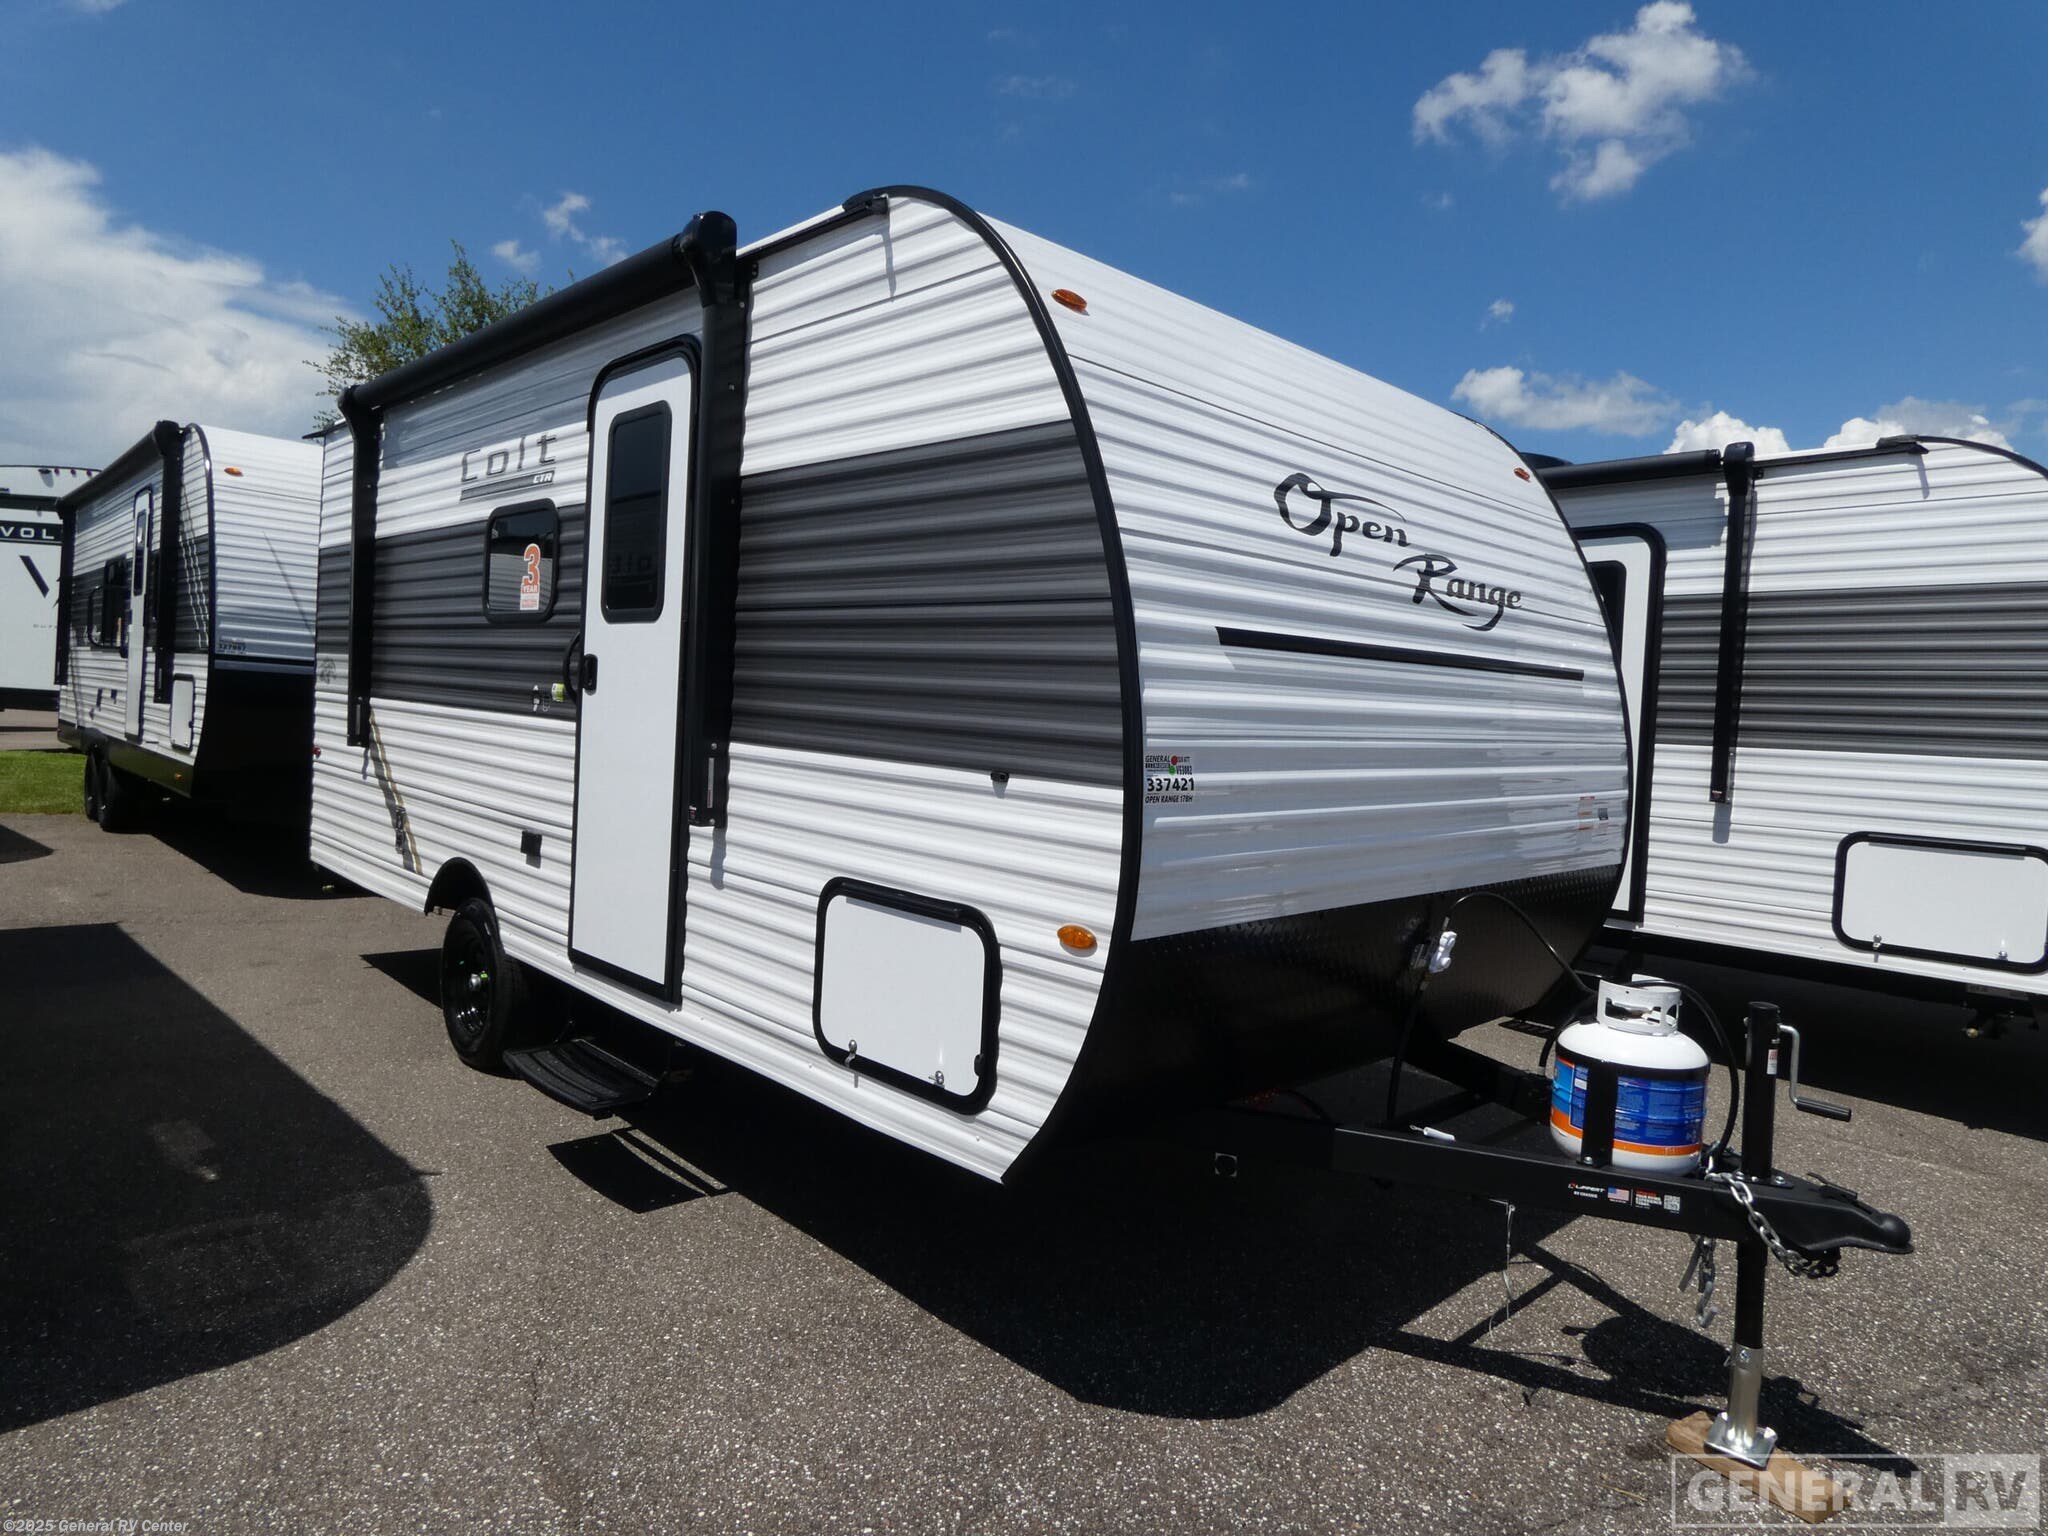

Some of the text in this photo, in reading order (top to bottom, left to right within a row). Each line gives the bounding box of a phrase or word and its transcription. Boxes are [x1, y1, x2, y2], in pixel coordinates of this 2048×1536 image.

[461, 433, 557, 483] Colt
[532, 472, 553, 484] CTR
[1273, 472, 1412, 557] Open
[523, 543, 541, 586] 3
[523, 584, 538, 593] YEAR
[1393, 553, 1522, 632] Range
[1147, 777, 1195, 792] 337421
[1145, 795, 1160, 804] OPEN
[1161, 795, 1180, 803] RANGE
